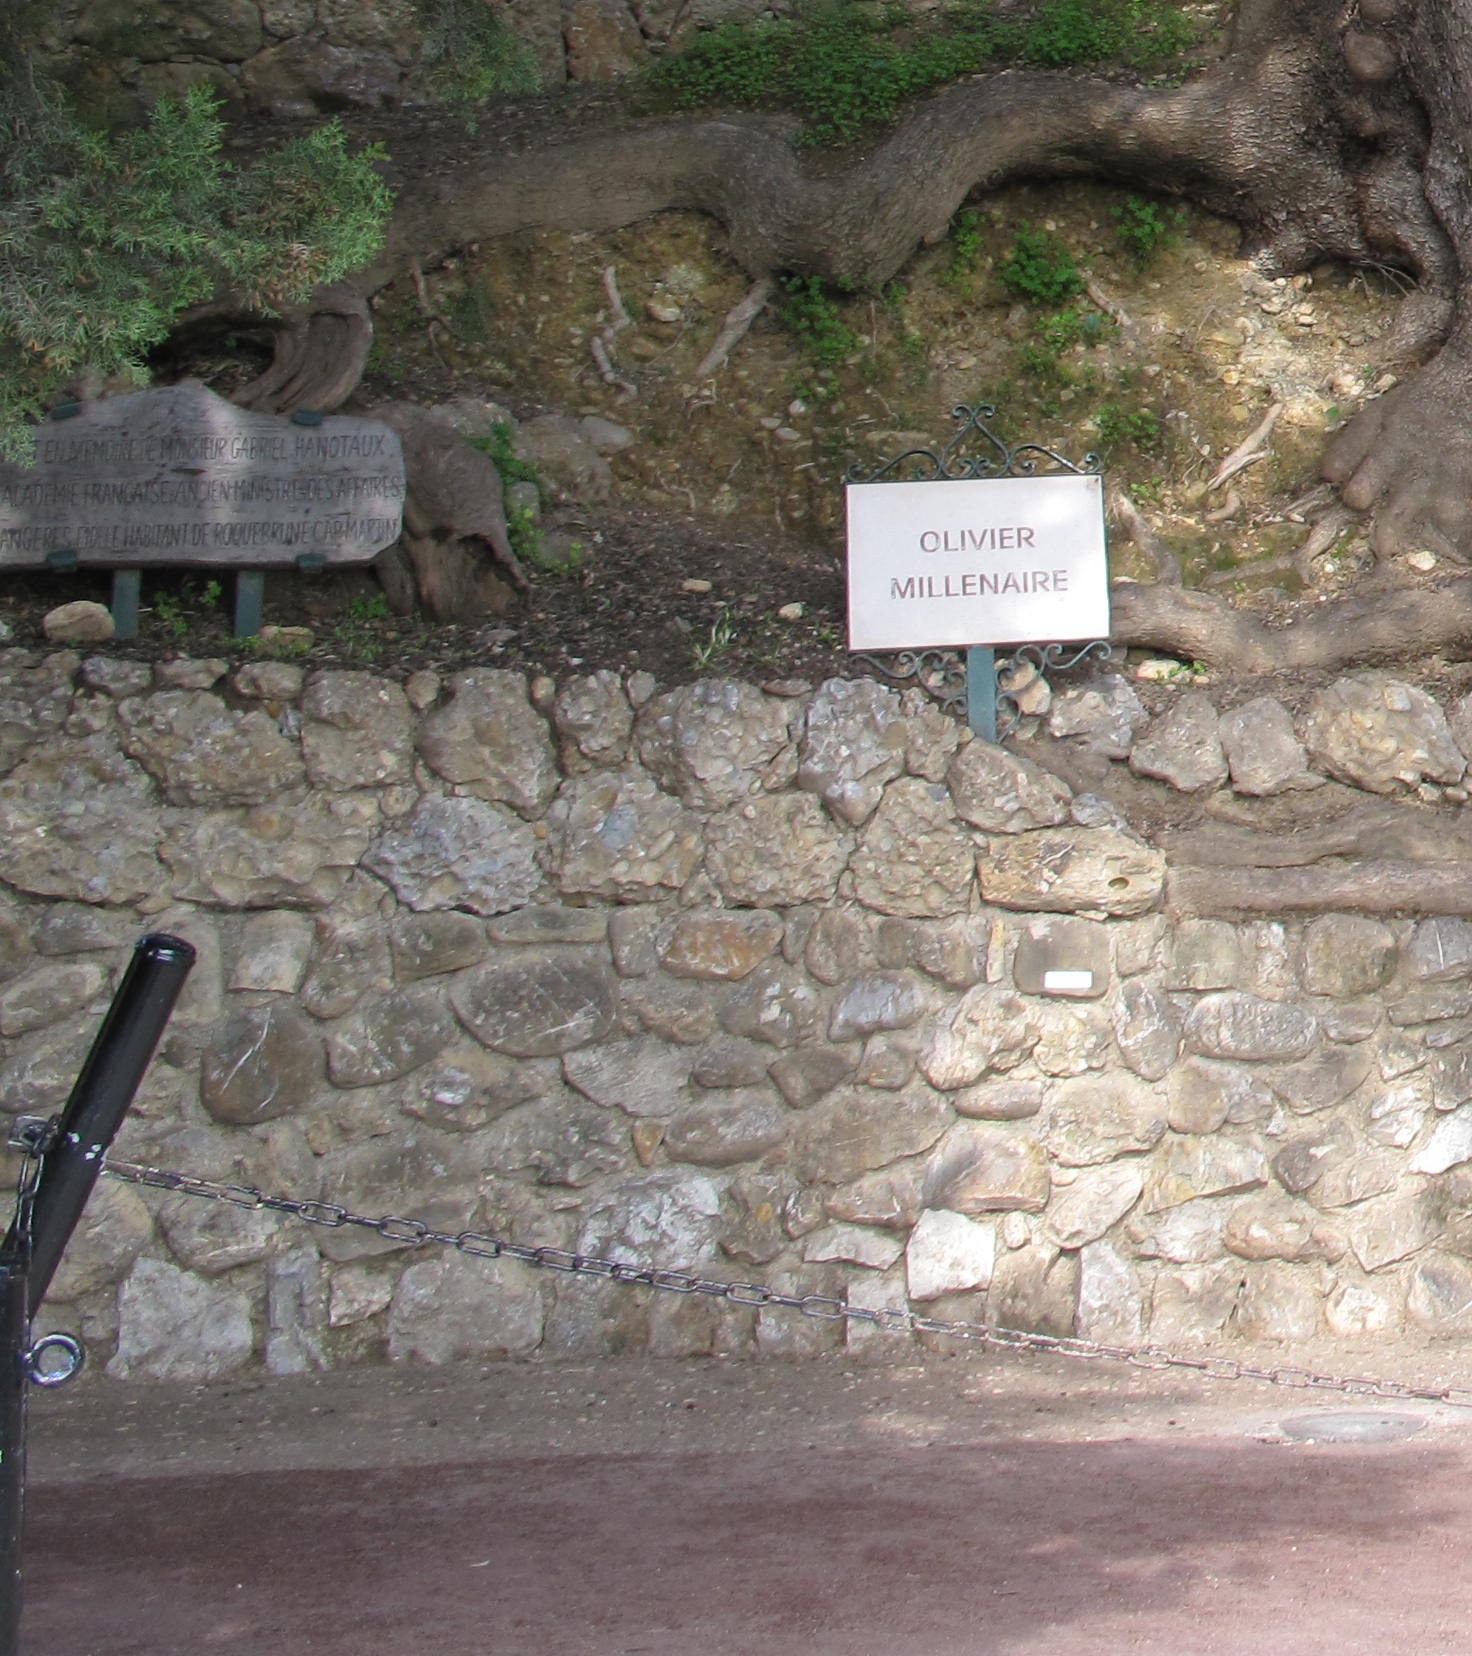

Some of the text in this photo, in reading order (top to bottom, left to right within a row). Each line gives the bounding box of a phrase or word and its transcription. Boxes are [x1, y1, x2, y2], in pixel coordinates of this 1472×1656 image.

[159, 435, 226, 461] MONSIEUR
[231, 436, 287, 460] GABRIEL
[124, 522, 188, 548] HABITANT
[192, 522, 210, 547] DE
[215, 520, 309, 546] ROQUEBRUNE
[920, 526, 1036, 553] OLIVIER
[890, 569, 1069, 600] MILLENAIRE
